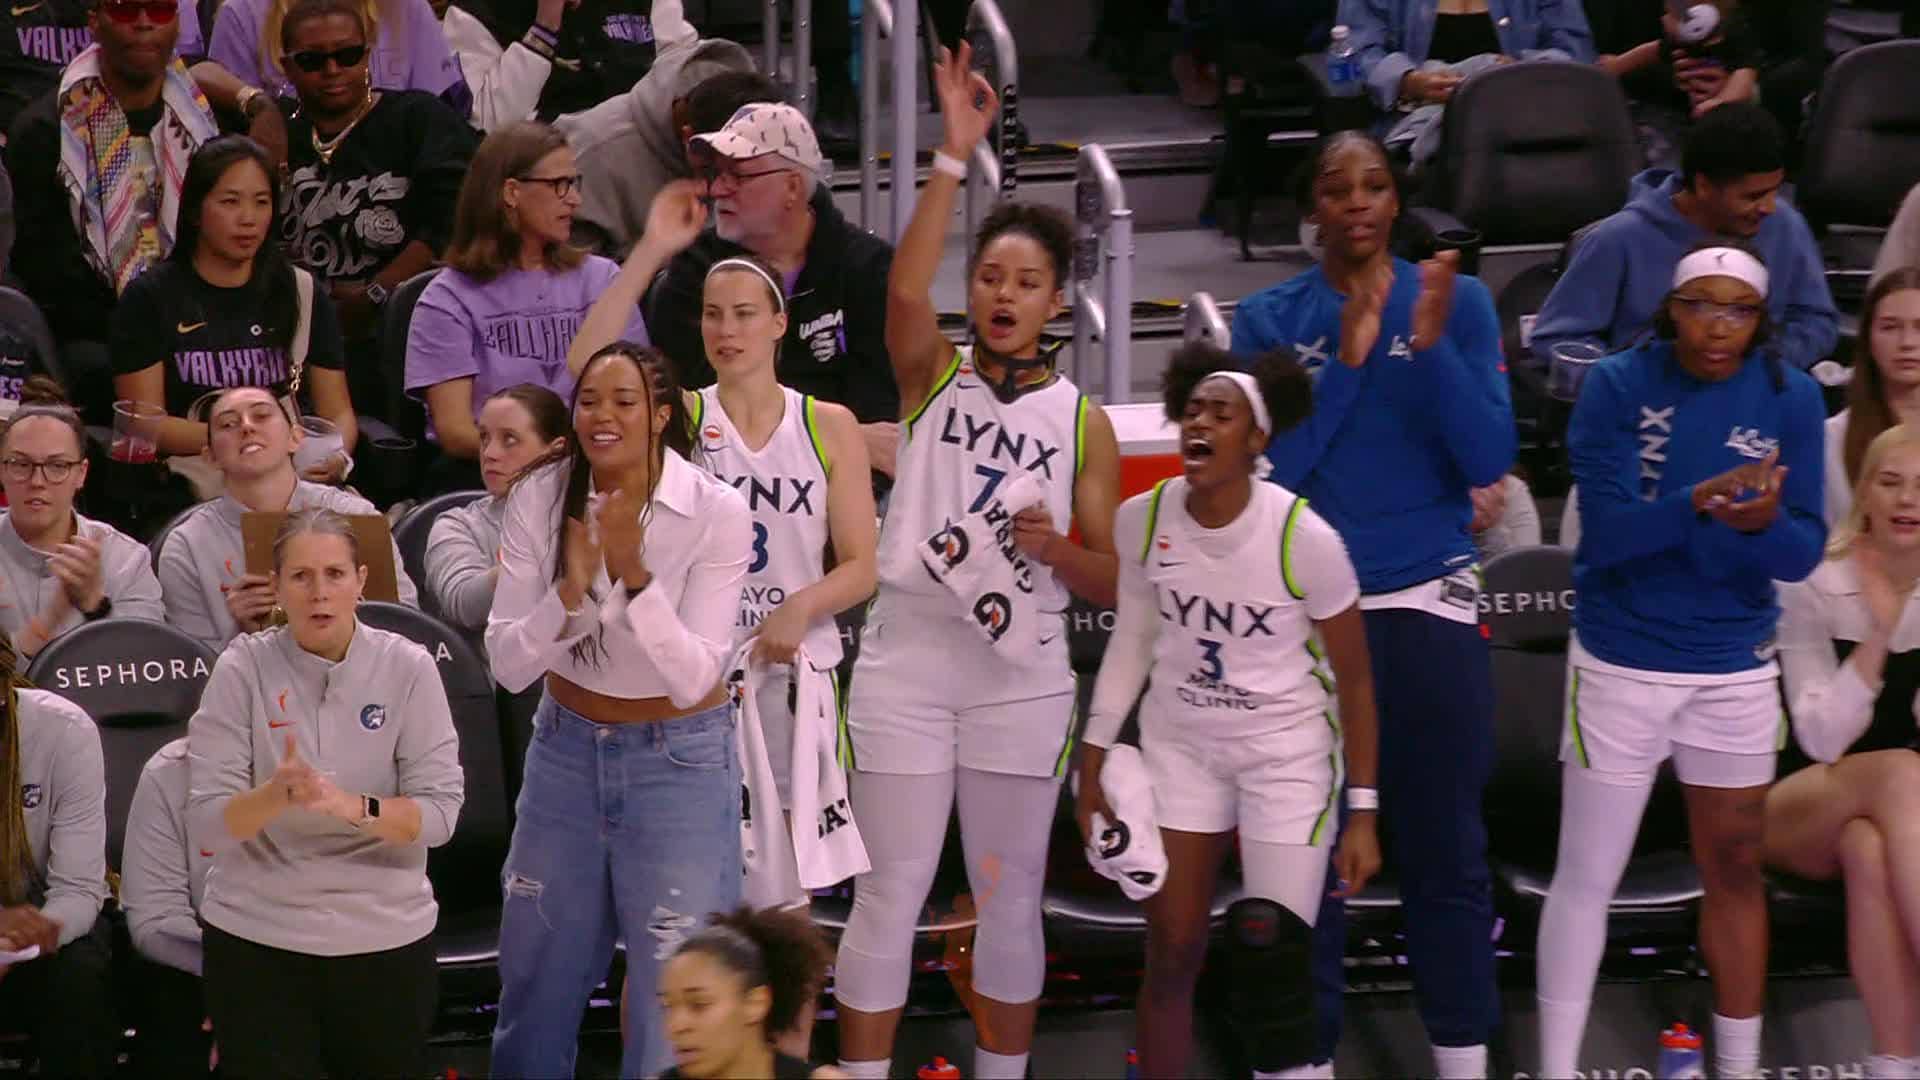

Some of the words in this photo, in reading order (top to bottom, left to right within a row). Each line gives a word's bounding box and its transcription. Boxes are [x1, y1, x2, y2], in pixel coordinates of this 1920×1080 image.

[939, 407, 1061, 481] LYNX
[968, 464, 1007, 514] 7
[1153, 583, 1276, 638] LYNX
[56, 657, 209, 689] SEPHORA
[1196, 637, 1223, 681] 3
